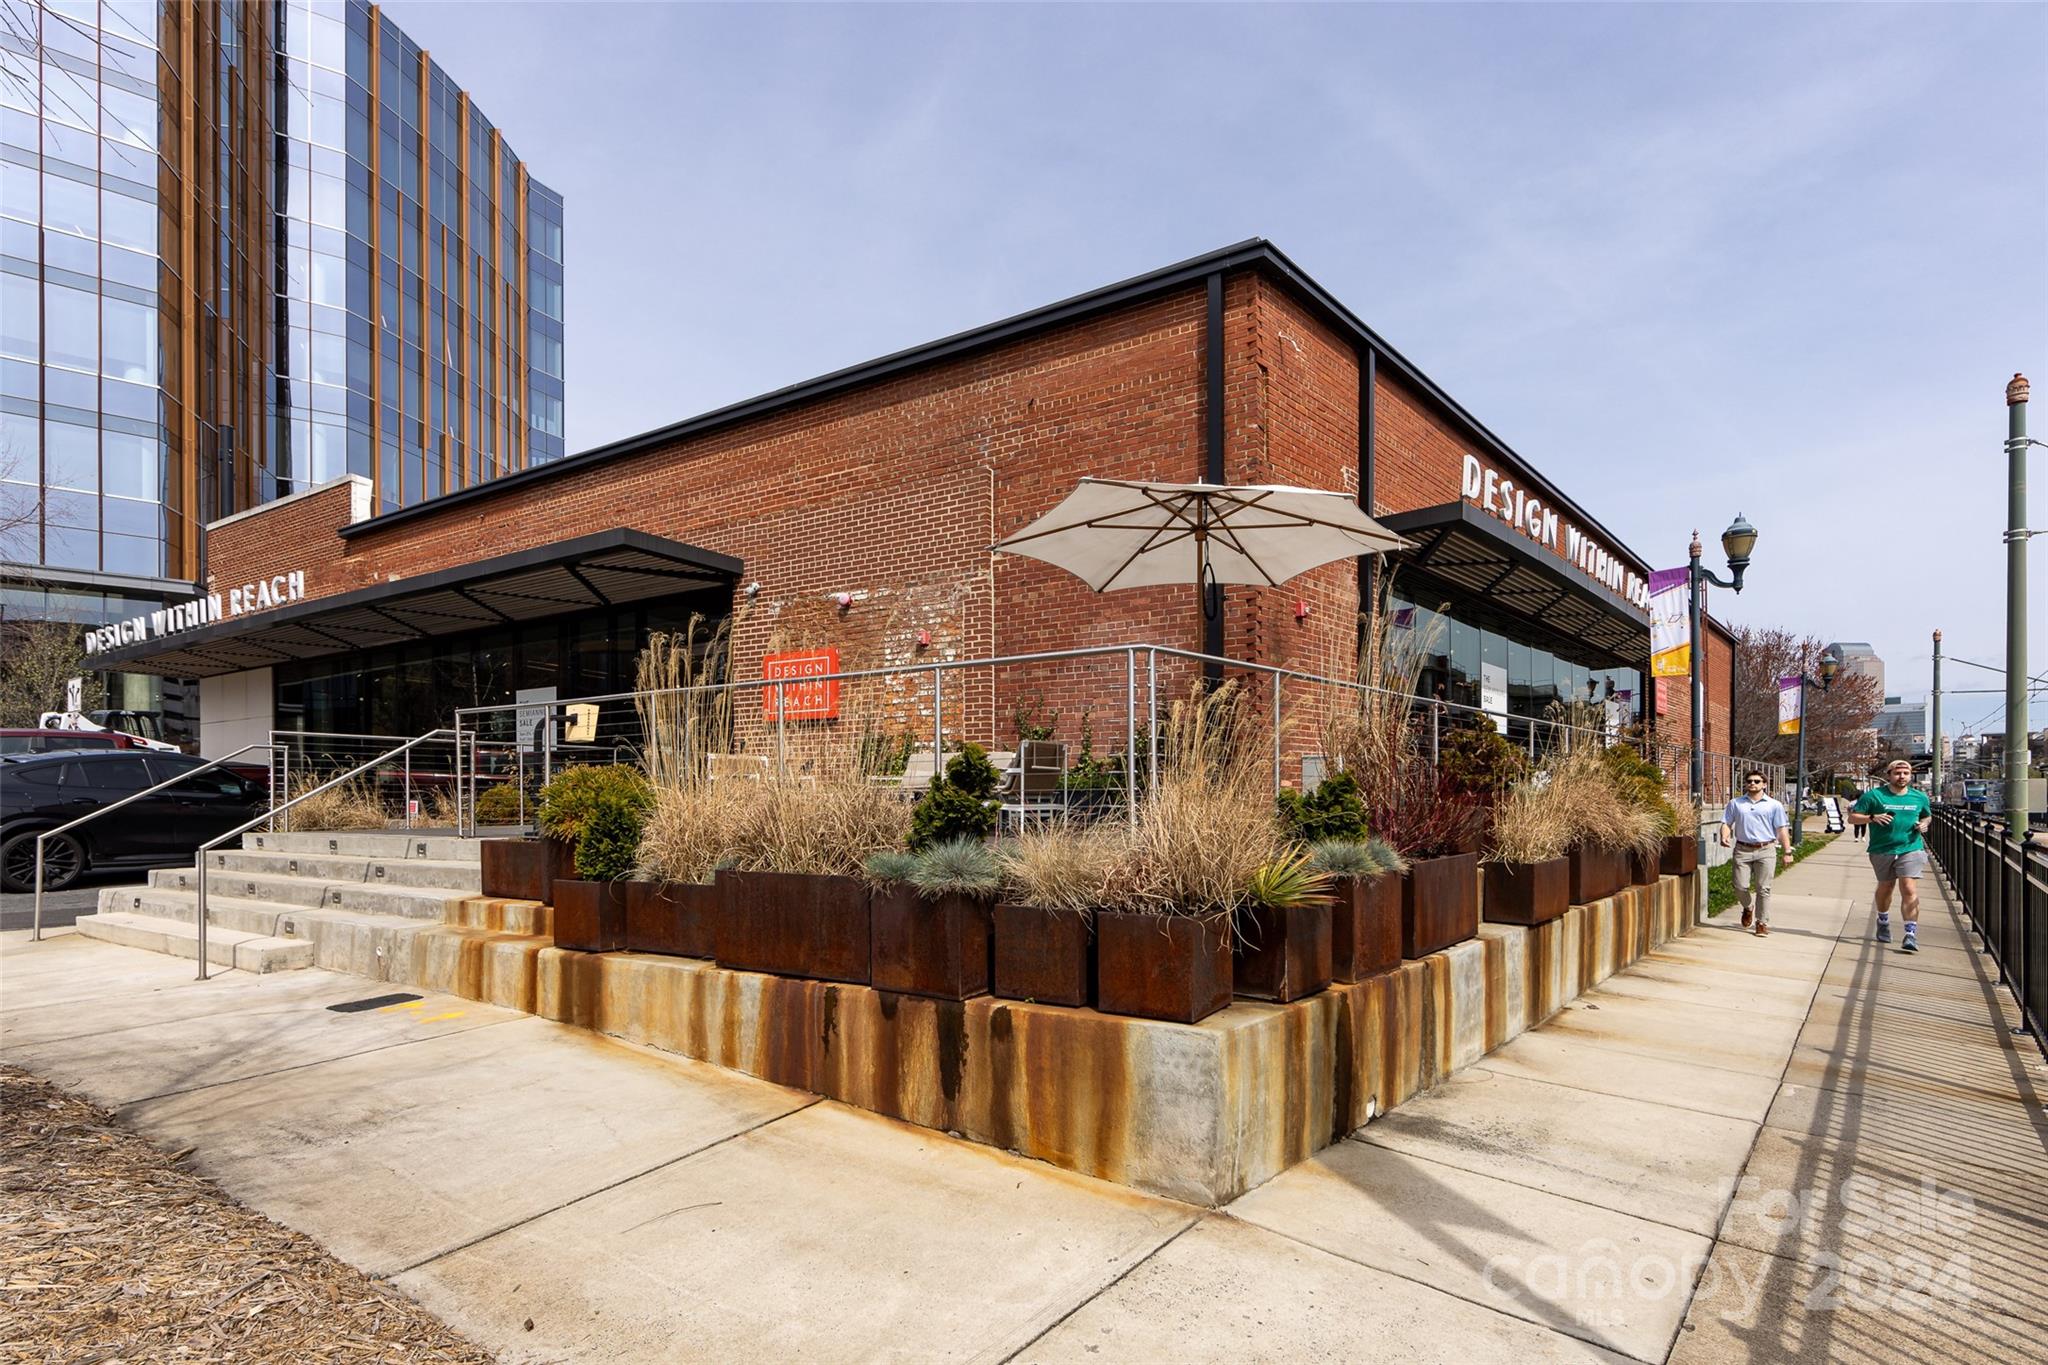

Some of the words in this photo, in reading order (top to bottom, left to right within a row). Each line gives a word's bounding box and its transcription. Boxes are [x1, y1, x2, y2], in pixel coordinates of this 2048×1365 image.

[1461, 454, 1558, 549] DESIGN
[1564, 523, 1624, 593] WITHIN
[1626, 571, 1650, 610] REA
[85, 616, 147, 654] DESIGN
[151, 593, 222, 638] WITHIN
[230, 570, 305, 616] REACH
[774, 663, 823, 677] DESIGN
[519, 718, 533, 727] SALE
